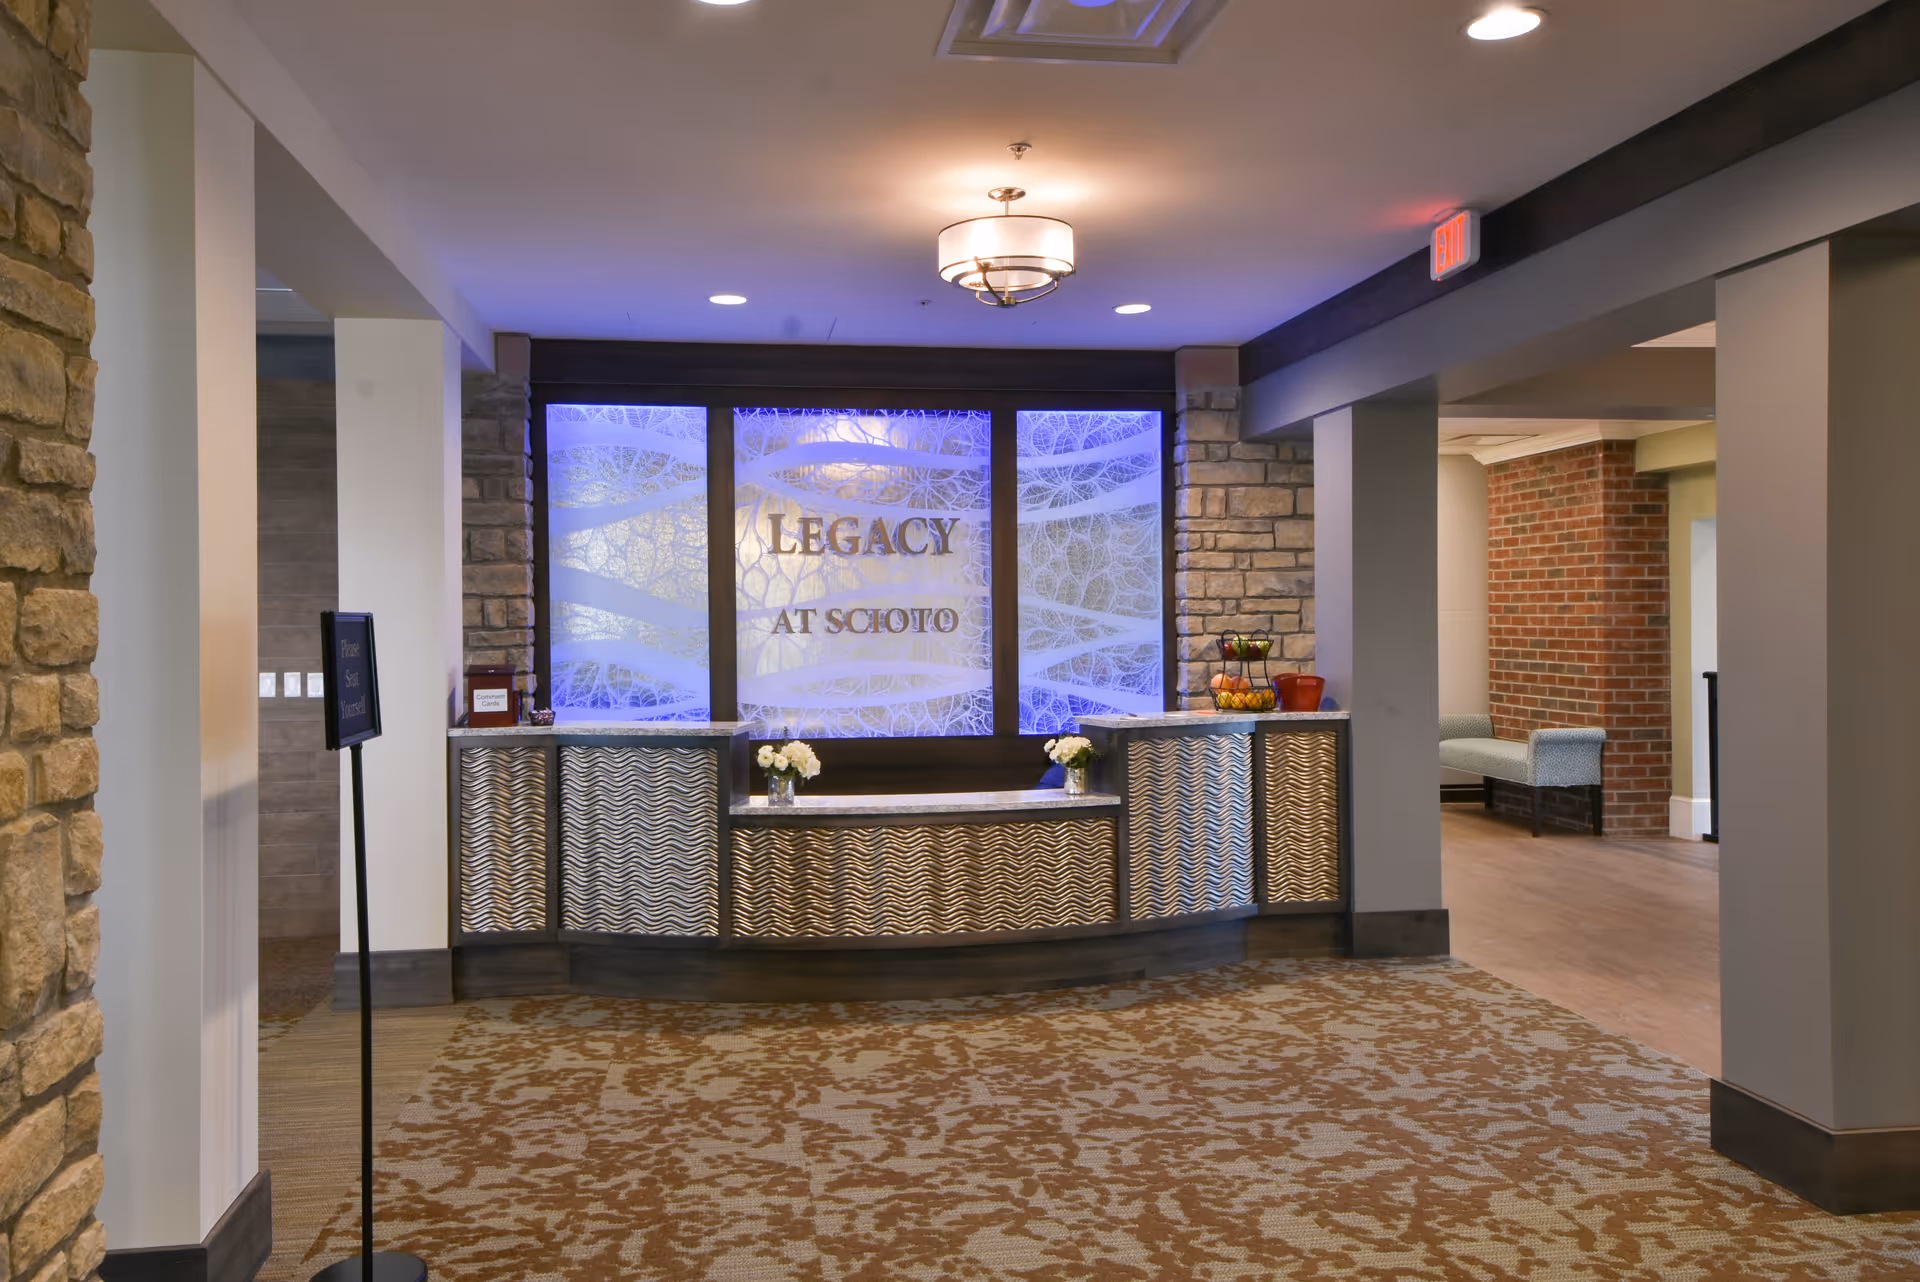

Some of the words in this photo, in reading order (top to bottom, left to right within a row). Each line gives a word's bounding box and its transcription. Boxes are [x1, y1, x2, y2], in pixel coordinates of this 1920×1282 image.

[1435, 213, 1466, 274] EXIT
[768, 513, 960, 555] LEGACY
[771, 608, 817, 634] AT
[825, 608, 959, 634] SCIOTO
[341, 639, 360, 658] Please
[345, 669, 360, 688] Seat
[341, 693, 367, 719] Yourself
